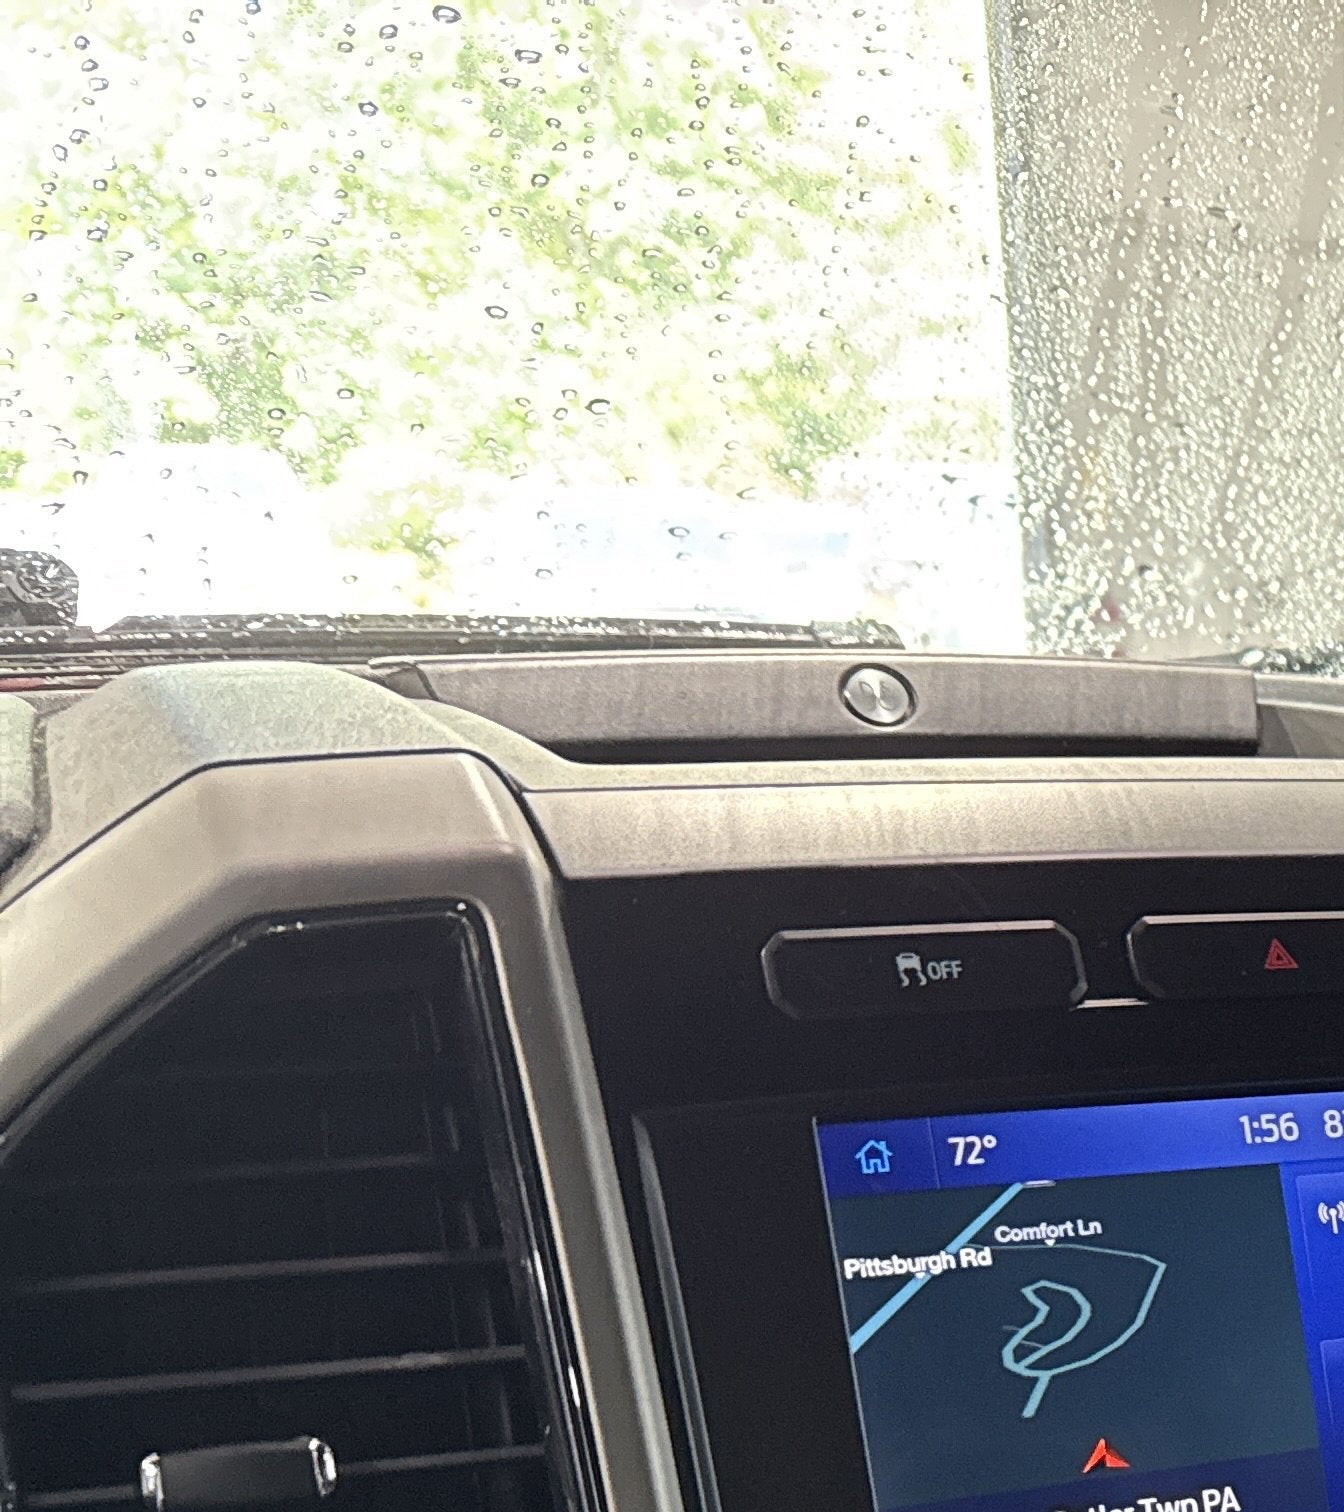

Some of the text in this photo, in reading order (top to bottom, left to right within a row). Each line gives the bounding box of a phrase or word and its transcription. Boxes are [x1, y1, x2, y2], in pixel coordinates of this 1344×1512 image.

[927, 957, 964, 981] OFF
[1238, 1112, 1300, 1144] 1:56
[947, 1133, 998, 1166] 72°
[993, 1218, 1103, 1243] Comfort Ln
[843, 1246, 993, 1281] Pittsburgh Rd
